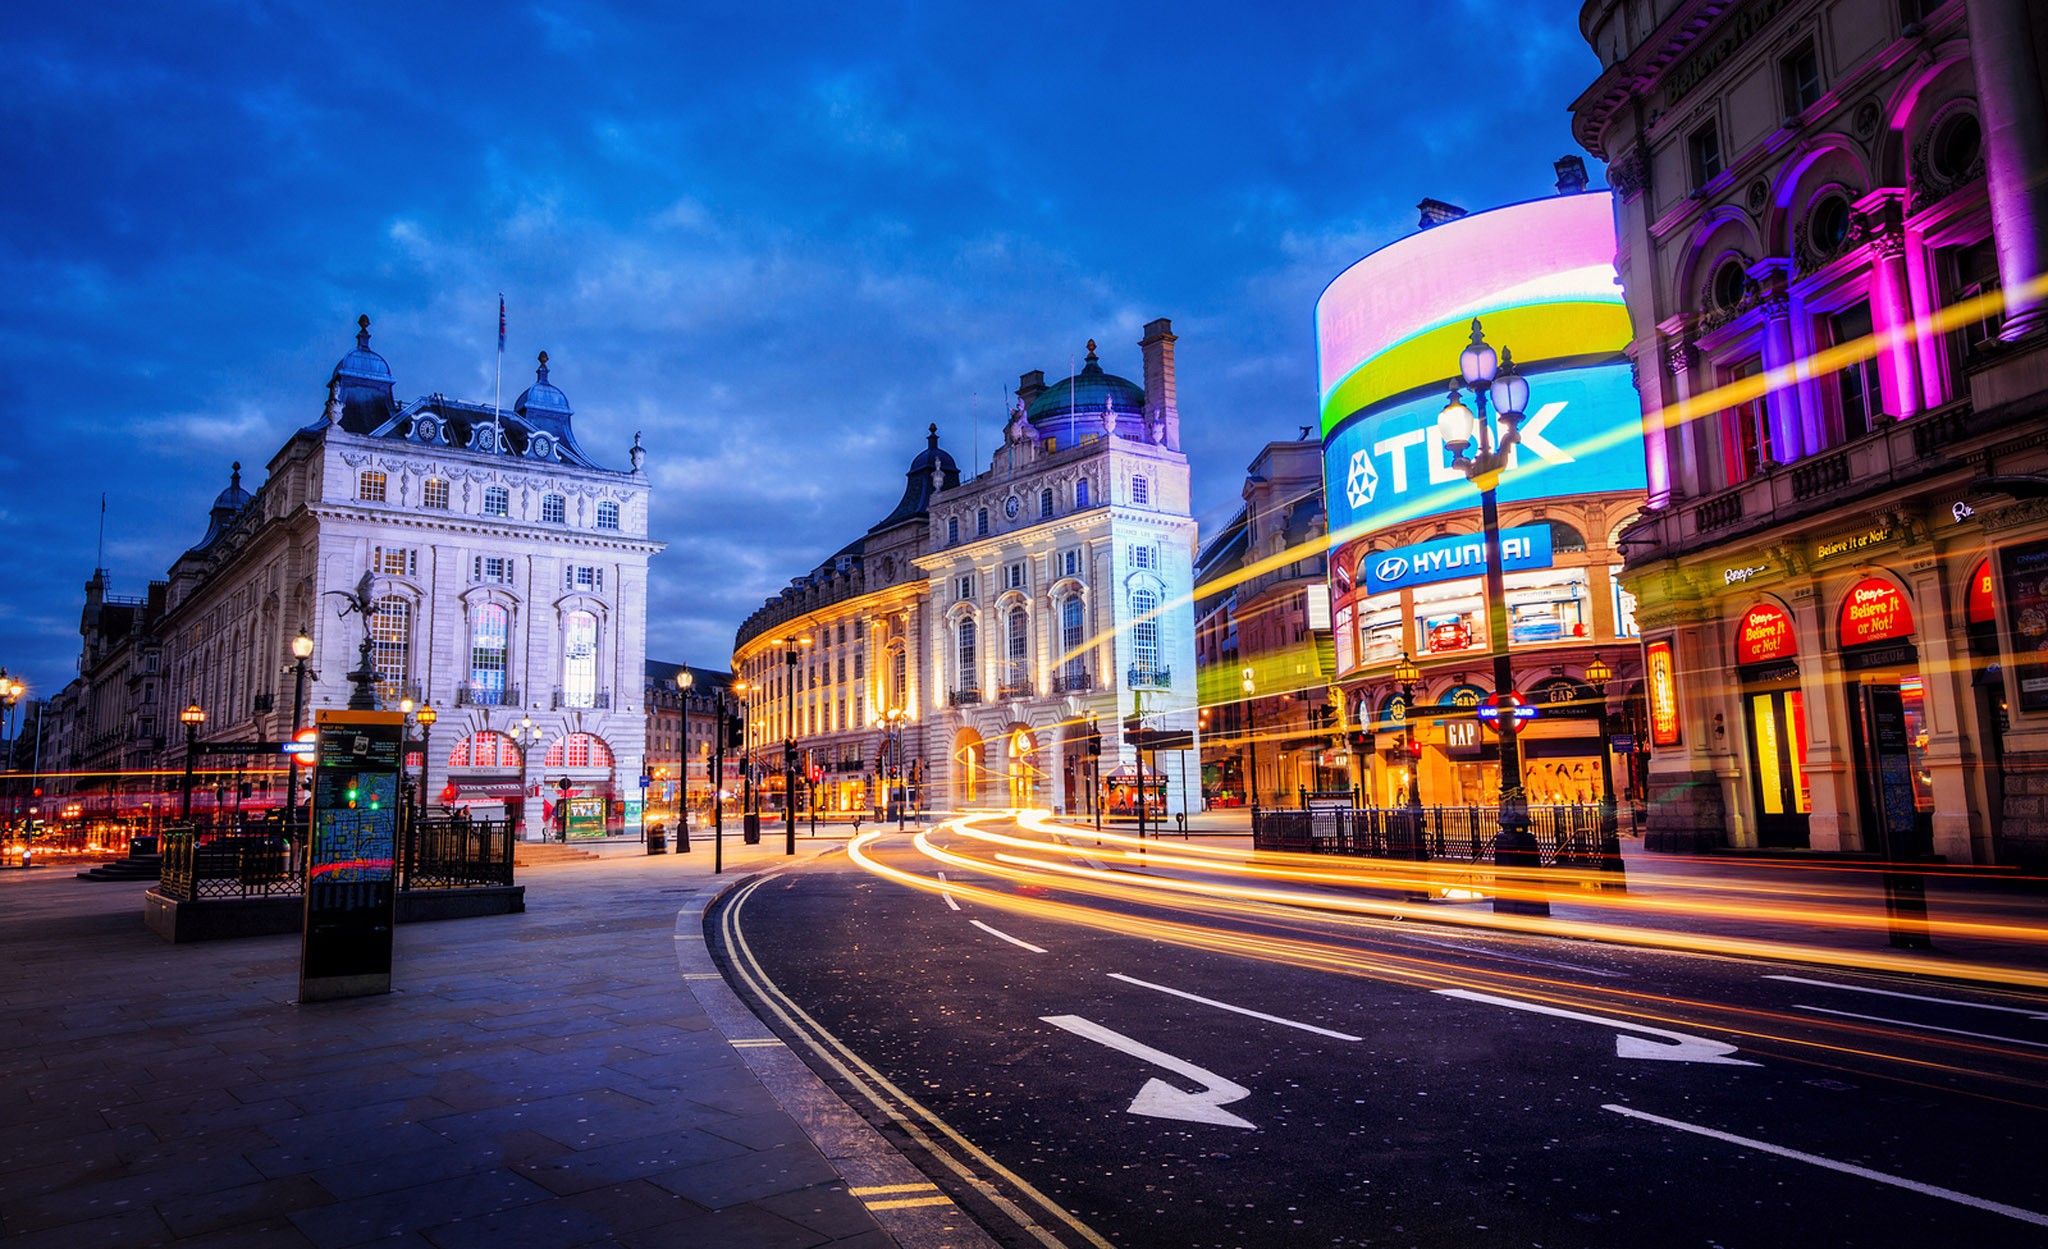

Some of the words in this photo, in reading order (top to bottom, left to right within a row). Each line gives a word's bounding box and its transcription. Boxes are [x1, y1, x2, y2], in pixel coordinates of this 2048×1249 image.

[1374, 401, 1576, 494] TDK
[1818, 541, 1848, 558] Believe
[1849, 536, 1857, 549] It
[1849, 602, 1887, 620] Believe
[1889, 596, 1900, 612] It
[1745, 626, 1776, 641] Believe
[1777, 621, 1786, 634] It
[1857, 623, 1869, 635] or
[1871, 613, 1894, 633] Not!
[1751, 644, 1761, 655] or
[1762, 636, 1781, 653] Not!
[1550, 690, 1574, 702] GAP
[1480, 708, 1534, 717] UNDOUND
[1449, 723, 1475, 747] GAP
